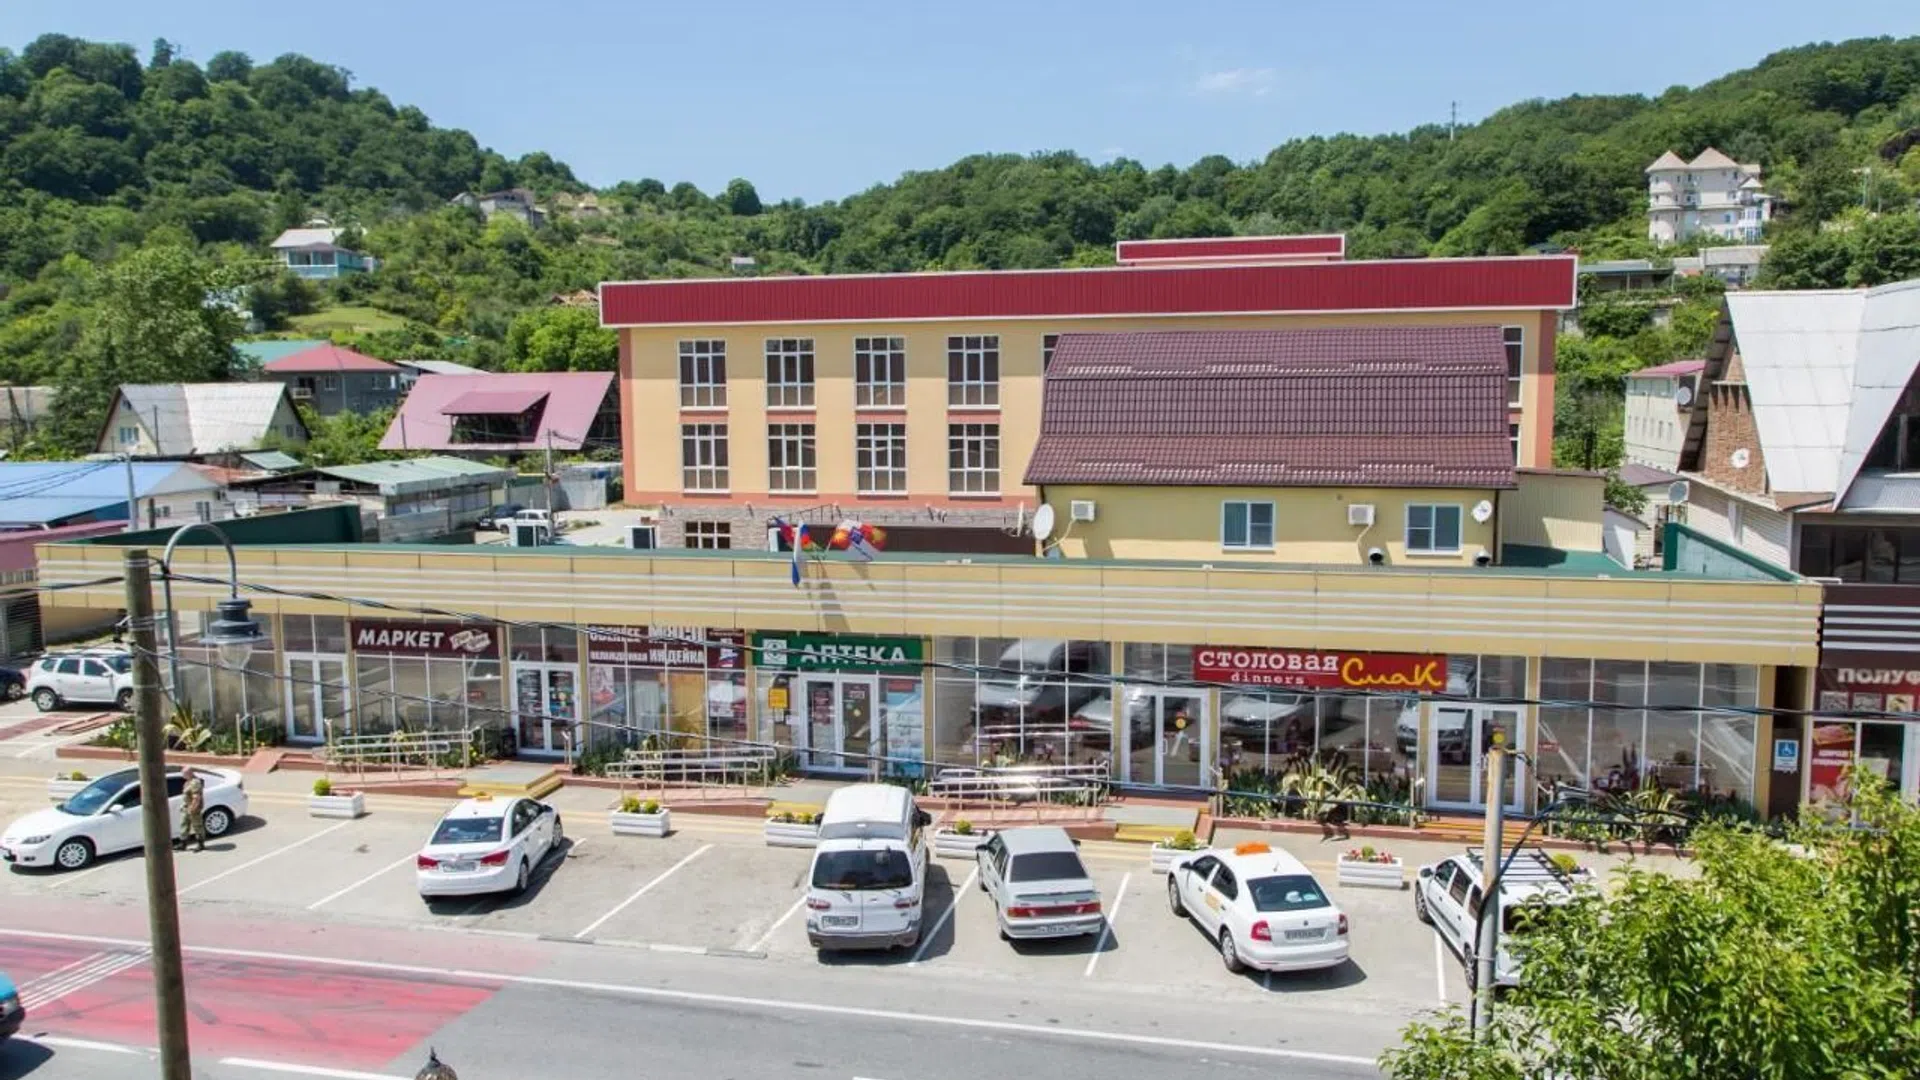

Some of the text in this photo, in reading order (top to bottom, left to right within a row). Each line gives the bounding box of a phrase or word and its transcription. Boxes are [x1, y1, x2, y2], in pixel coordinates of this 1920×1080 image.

[358, 628, 445, 648] МАРКЕТ
[799, 643, 907, 665] АПТЕКА
[1231, 672, 1304, 685] dinners
